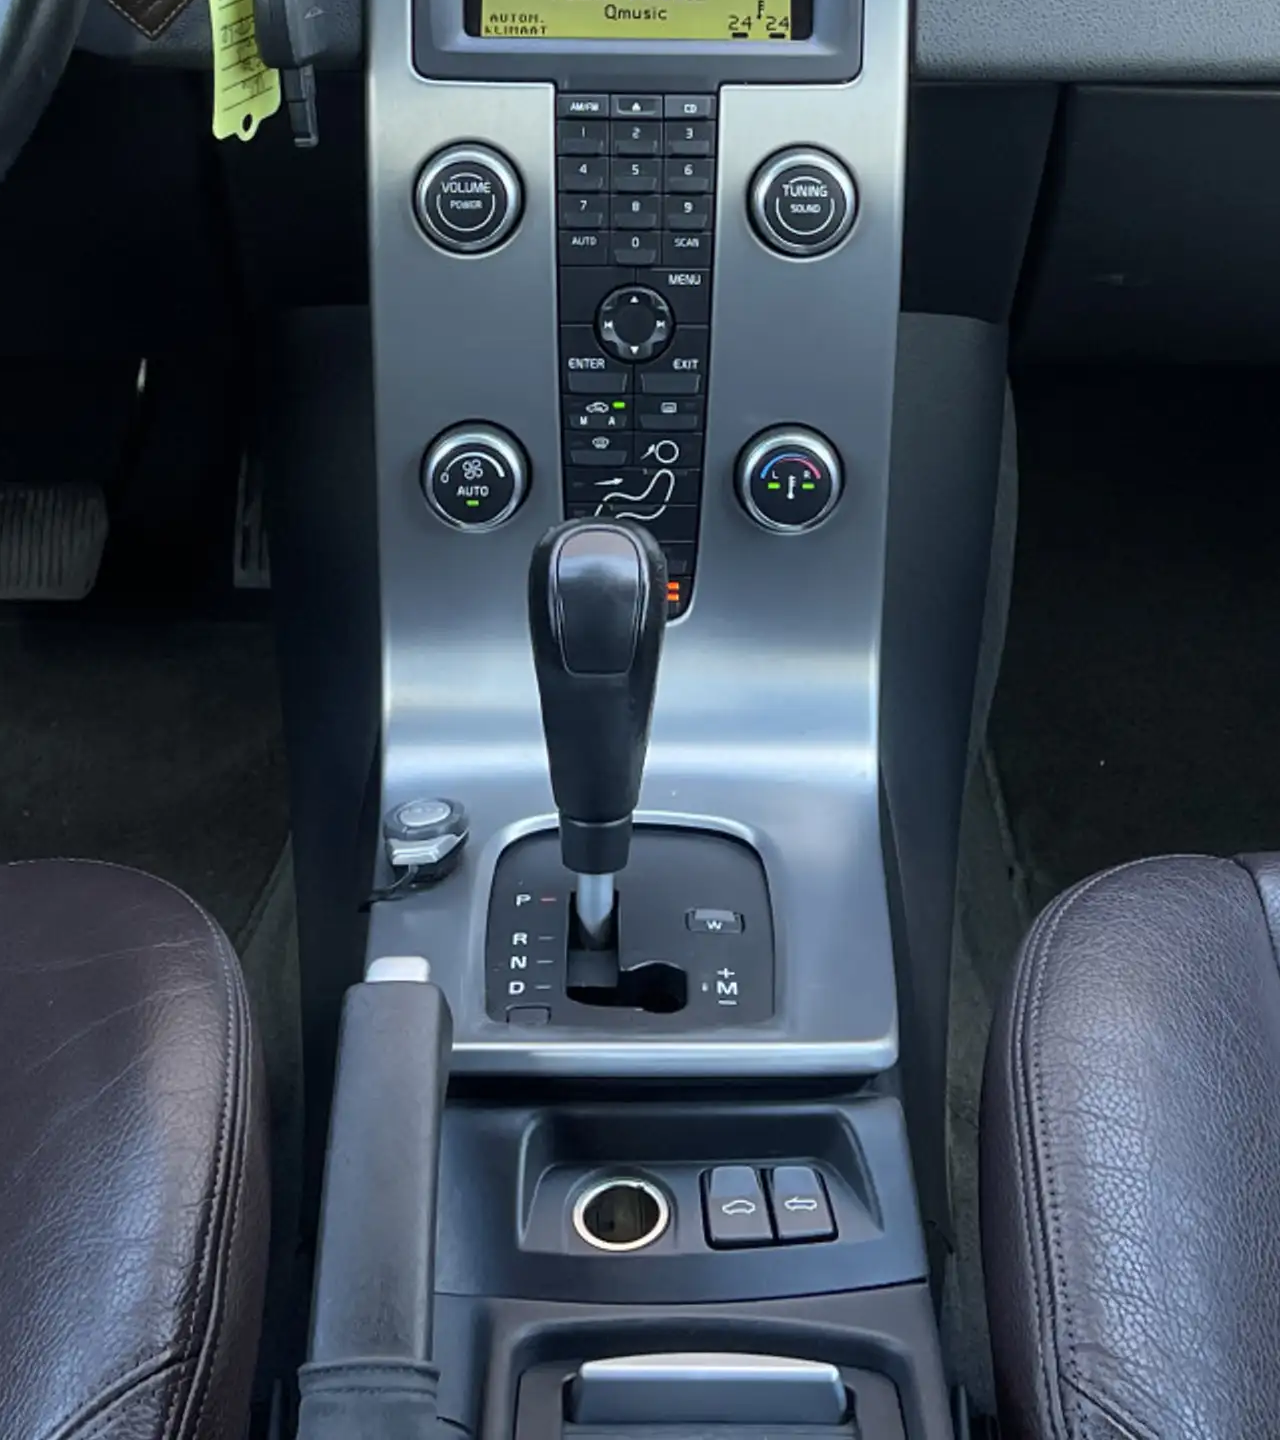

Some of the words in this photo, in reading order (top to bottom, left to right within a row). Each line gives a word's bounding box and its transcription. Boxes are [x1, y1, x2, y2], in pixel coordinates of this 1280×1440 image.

[603, 4, 667, 21] Qmusic
[728, 16, 752, 30] 24
[765, 16, 789, 31] 24
[684, 104, 698, 114] CD
[631, 128, 641, 140] 2
[685, 128, 694, 140] 3
[578, 164, 588, 175] 4
[631, 164, 640, 176] 5
[683, 164, 693, 176] 6
[441, 181, 492, 194] VOLUME
[782, 184, 828, 198] TUNING
[450, 199, 482, 210] POWER
[579, 200, 588, 211] 7
[631, 201, 641, 212] 8
[683, 201, 693, 213] 9
[790, 203, 822, 213] SOUND
[571, 236, 597, 246] AUTO
[631, 237, 640, 248] 0
[674, 237, 700, 248] SCAN
[668, 274, 702, 286] MENU
[568, 357, 606, 370] ENTER
[672, 358, 699, 370] EXIT
[579, 416, 588, 426] M
[608, 416, 616, 426] A
[771, 470, 780, 480] L
[803, 469, 812, 480] R
[456, 485, 490, 498] AUTO
[515, 894, 532, 907] P
[706, 920, 723, 931] W
[512, 932, 529, 946] R
[510, 955, 528, 970] N
[508, 982, 526, 996] D
[716, 980, 739, 996] M
